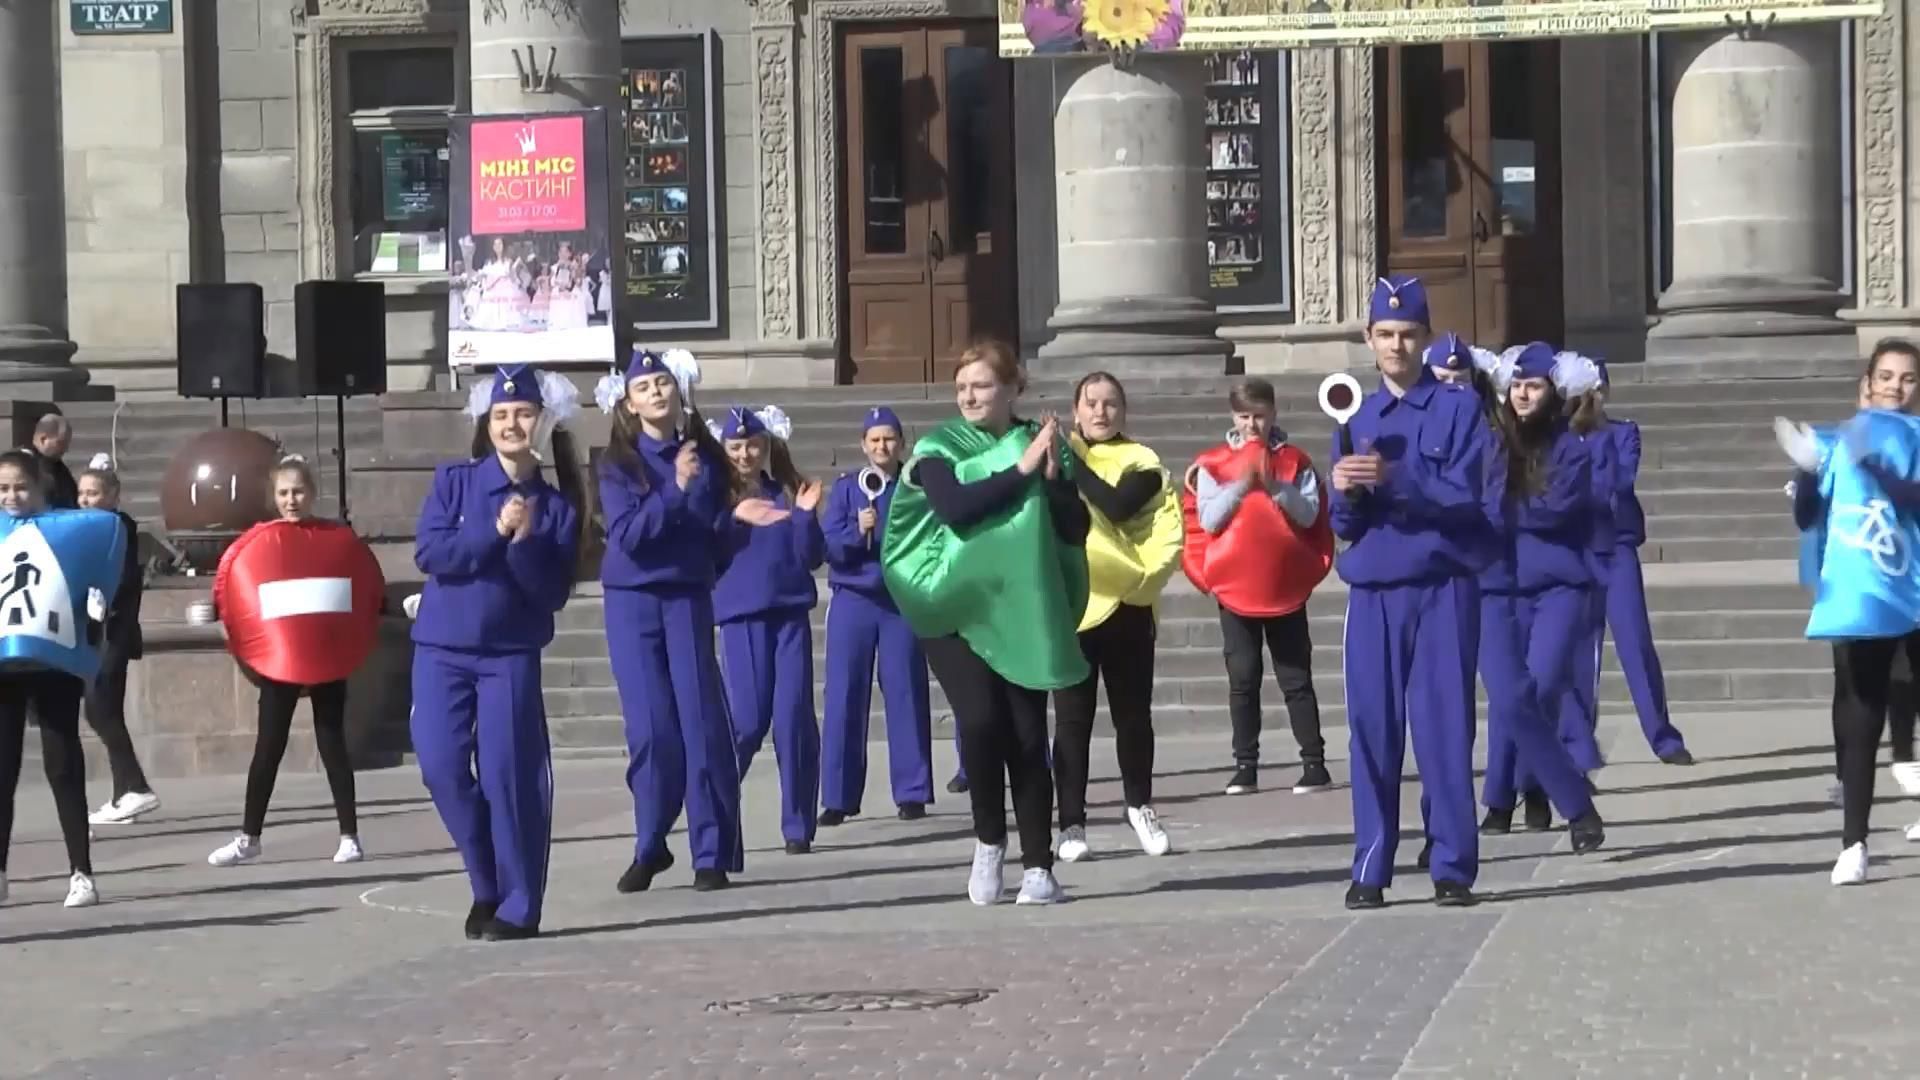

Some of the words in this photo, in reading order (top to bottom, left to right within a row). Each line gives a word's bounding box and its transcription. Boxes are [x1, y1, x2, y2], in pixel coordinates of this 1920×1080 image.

[81, 4, 159, 22] ТЕАТР
[480, 158, 530, 177] МІНІ
[534, 156, 577, 175] МІС
[480, 175, 577, 201] КАСТИНГ
